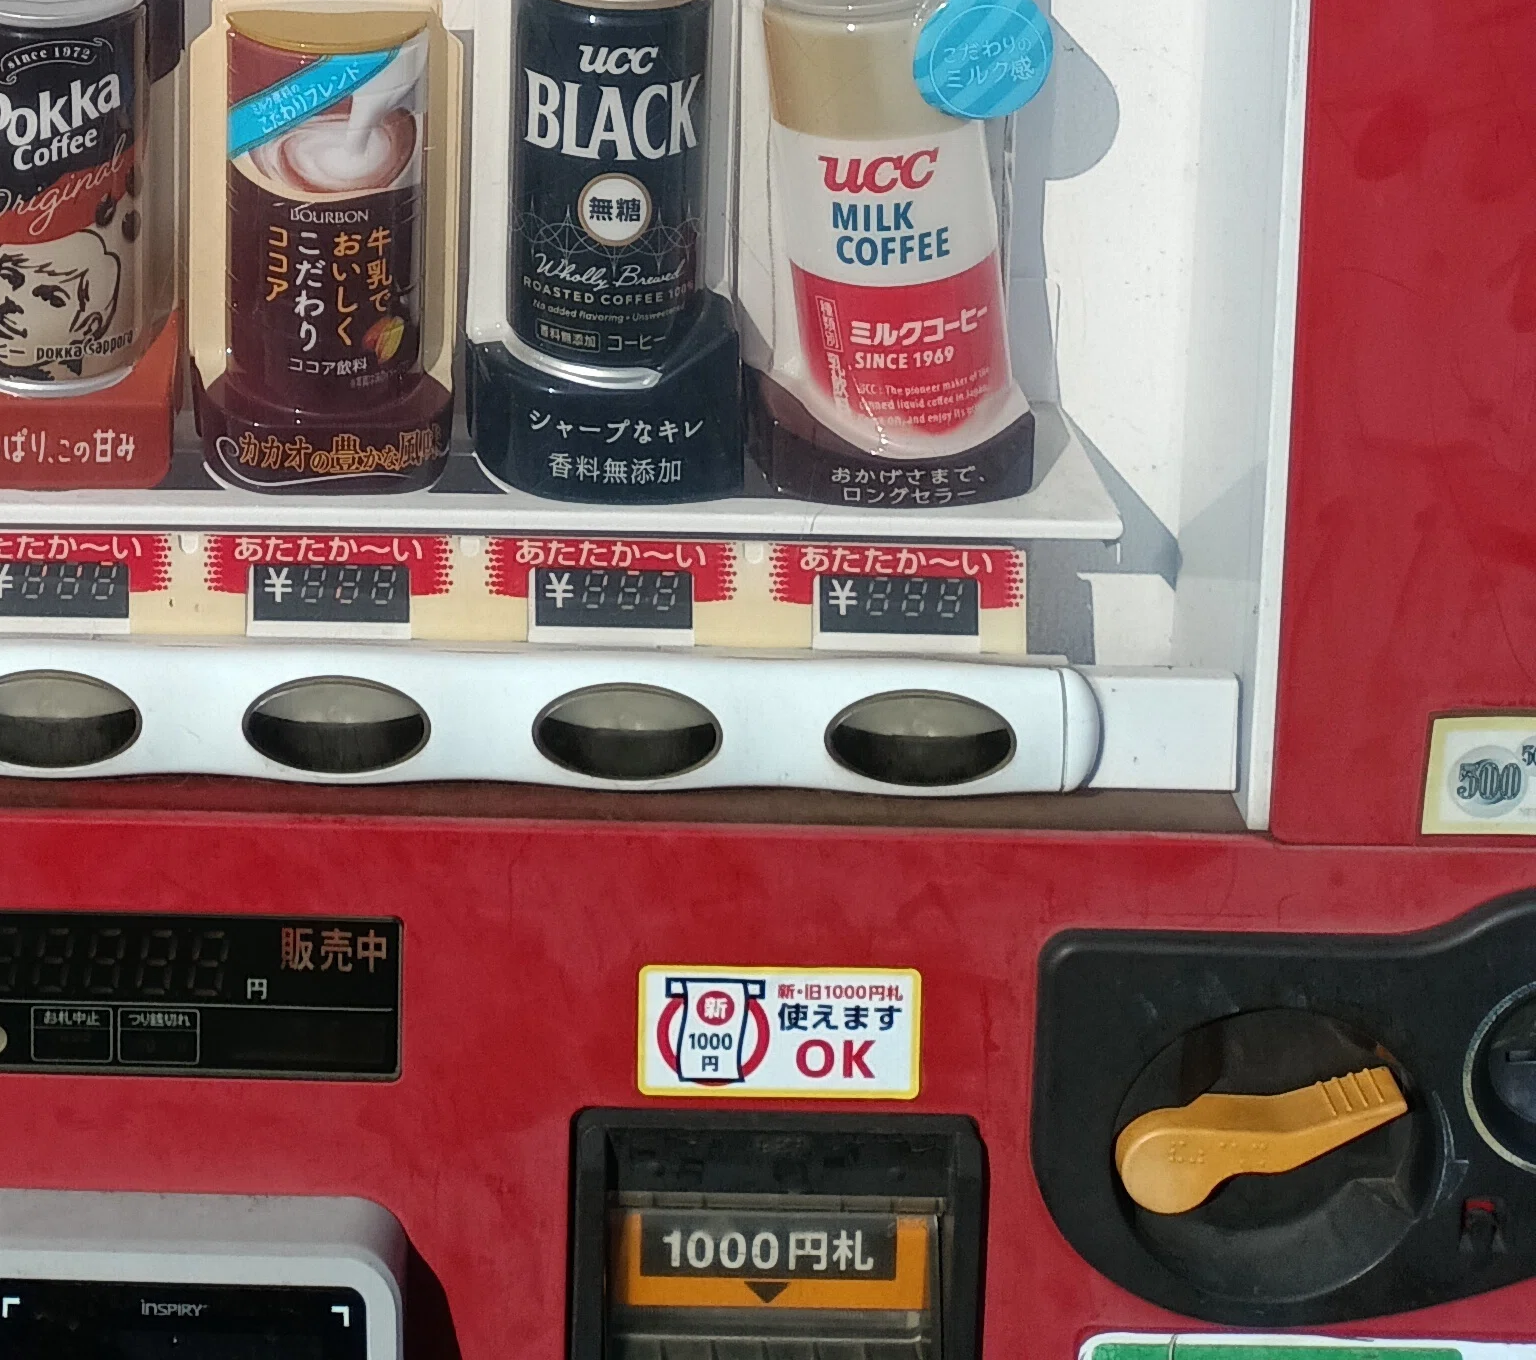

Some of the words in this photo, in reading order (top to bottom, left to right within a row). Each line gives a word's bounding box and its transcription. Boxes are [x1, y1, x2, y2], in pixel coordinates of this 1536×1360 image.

[53, 46, 91, 62] 1972
[524, 70, 701, 161] BLACK
[13, 126, 98, 172] Coffee
[291, 208, 368, 224] BOURBON
[588, 197, 641, 224] 無糖
[833, 201, 914, 231] MILK
[836, 226, 950, 266] COFFEE
[267, 227, 288, 302] ココア
[295, 233, 325, 351] こだわり
[334, 231, 361, 346] おいしく
[601, 292, 663, 305] COFFEE
[608, 334, 666, 350] コーヒー
[289, 357, 366, 374] ココア飲料
[855, 352, 908, 369] SINCE
[914, 346, 954, 367] 1969
[529, 409, 703, 444] シャープなキレ
[548, 452, 681, 484] 香料無添加
[844, 488, 975, 505] ロングセラー
[1456, 759, 1522, 801] 500
[281, 928, 387, 973] 販売中
[247, 978, 267, 1000] 円
[778, 1004, 903, 1032] 使えます
[688, 1032, 733, 1051] 1000
[701, 1056, 719, 1072] 円
[795, 1040, 876, 1079] OK
[663, 1228, 875, 1272] 1000円札
